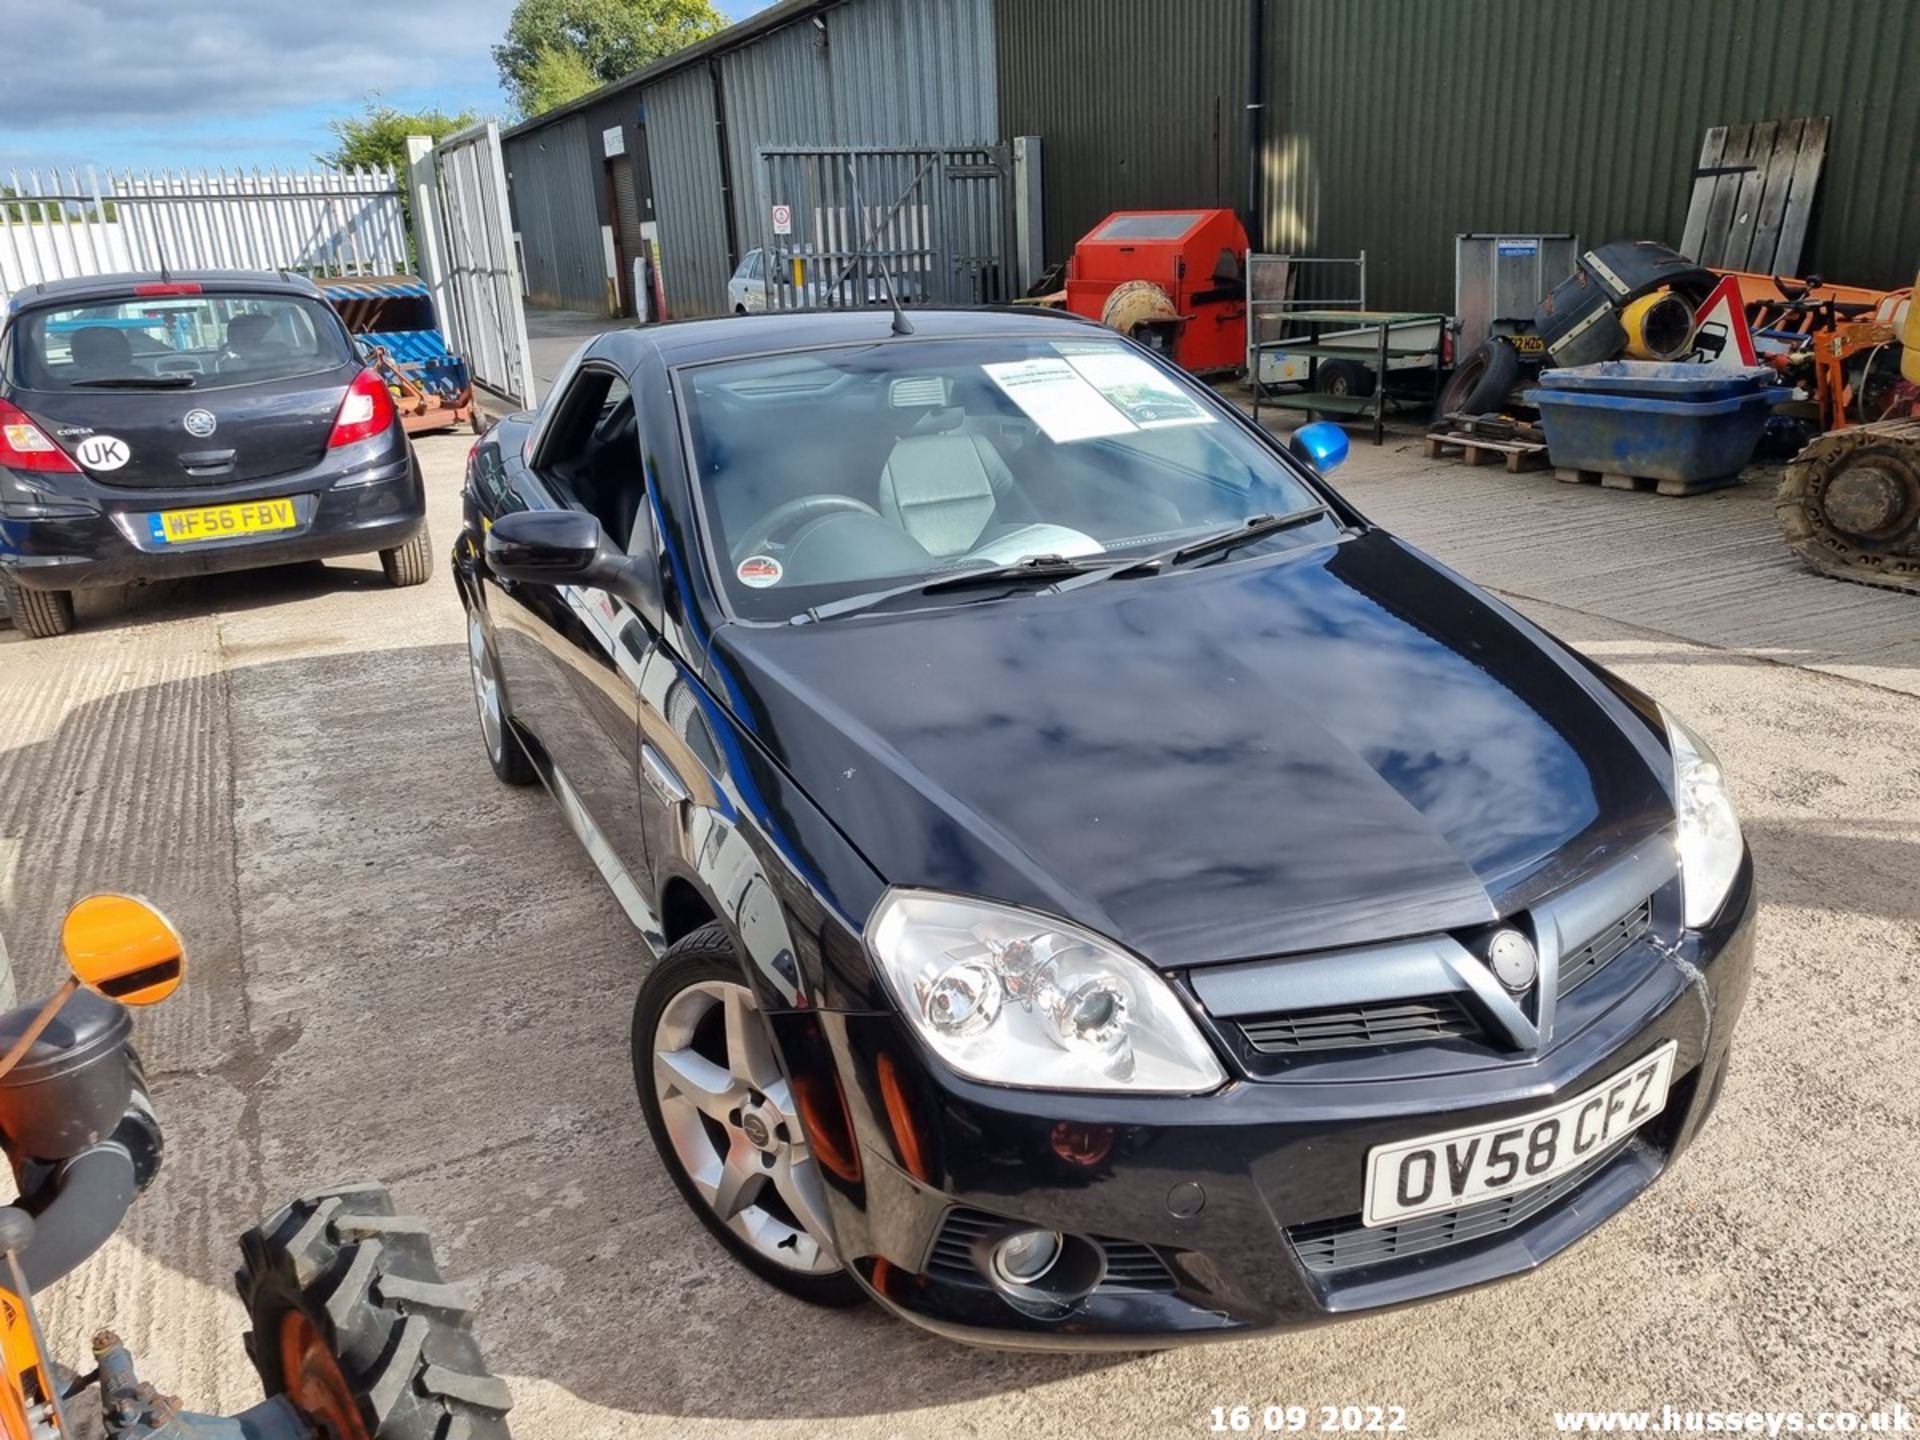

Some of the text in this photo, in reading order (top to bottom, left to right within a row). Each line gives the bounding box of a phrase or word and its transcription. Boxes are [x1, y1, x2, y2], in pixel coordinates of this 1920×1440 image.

[57, 426, 94, 436] CORSA
[83, 442, 123, 465] UK
[167, 503, 289, 536] WF56 FBV
[1396, 1118, 1561, 1207] OV58
[1573, 1061, 1660, 1155] CFZ
